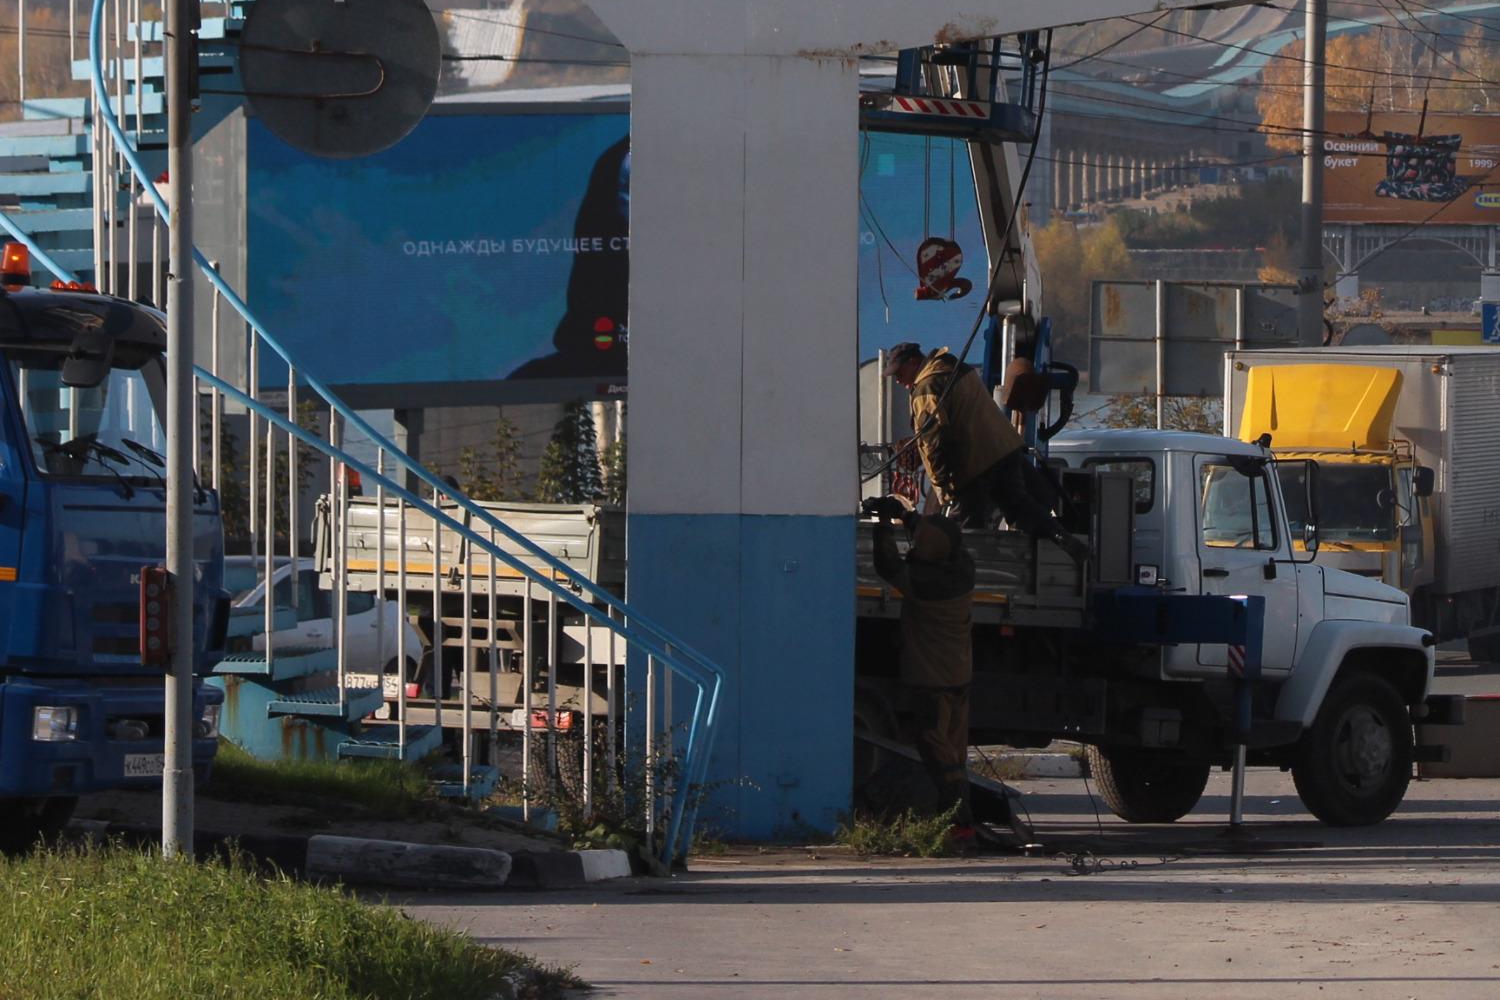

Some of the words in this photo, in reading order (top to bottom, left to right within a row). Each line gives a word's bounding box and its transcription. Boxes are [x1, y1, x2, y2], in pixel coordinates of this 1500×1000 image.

[1323, 140, 1379, 152] Осенний
[1324, 155, 1359, 169] букет
[403, 239, 505, 257] ОДНАЖДЫ
[512, 237, 603, 254] БУДУЩЕЕ
